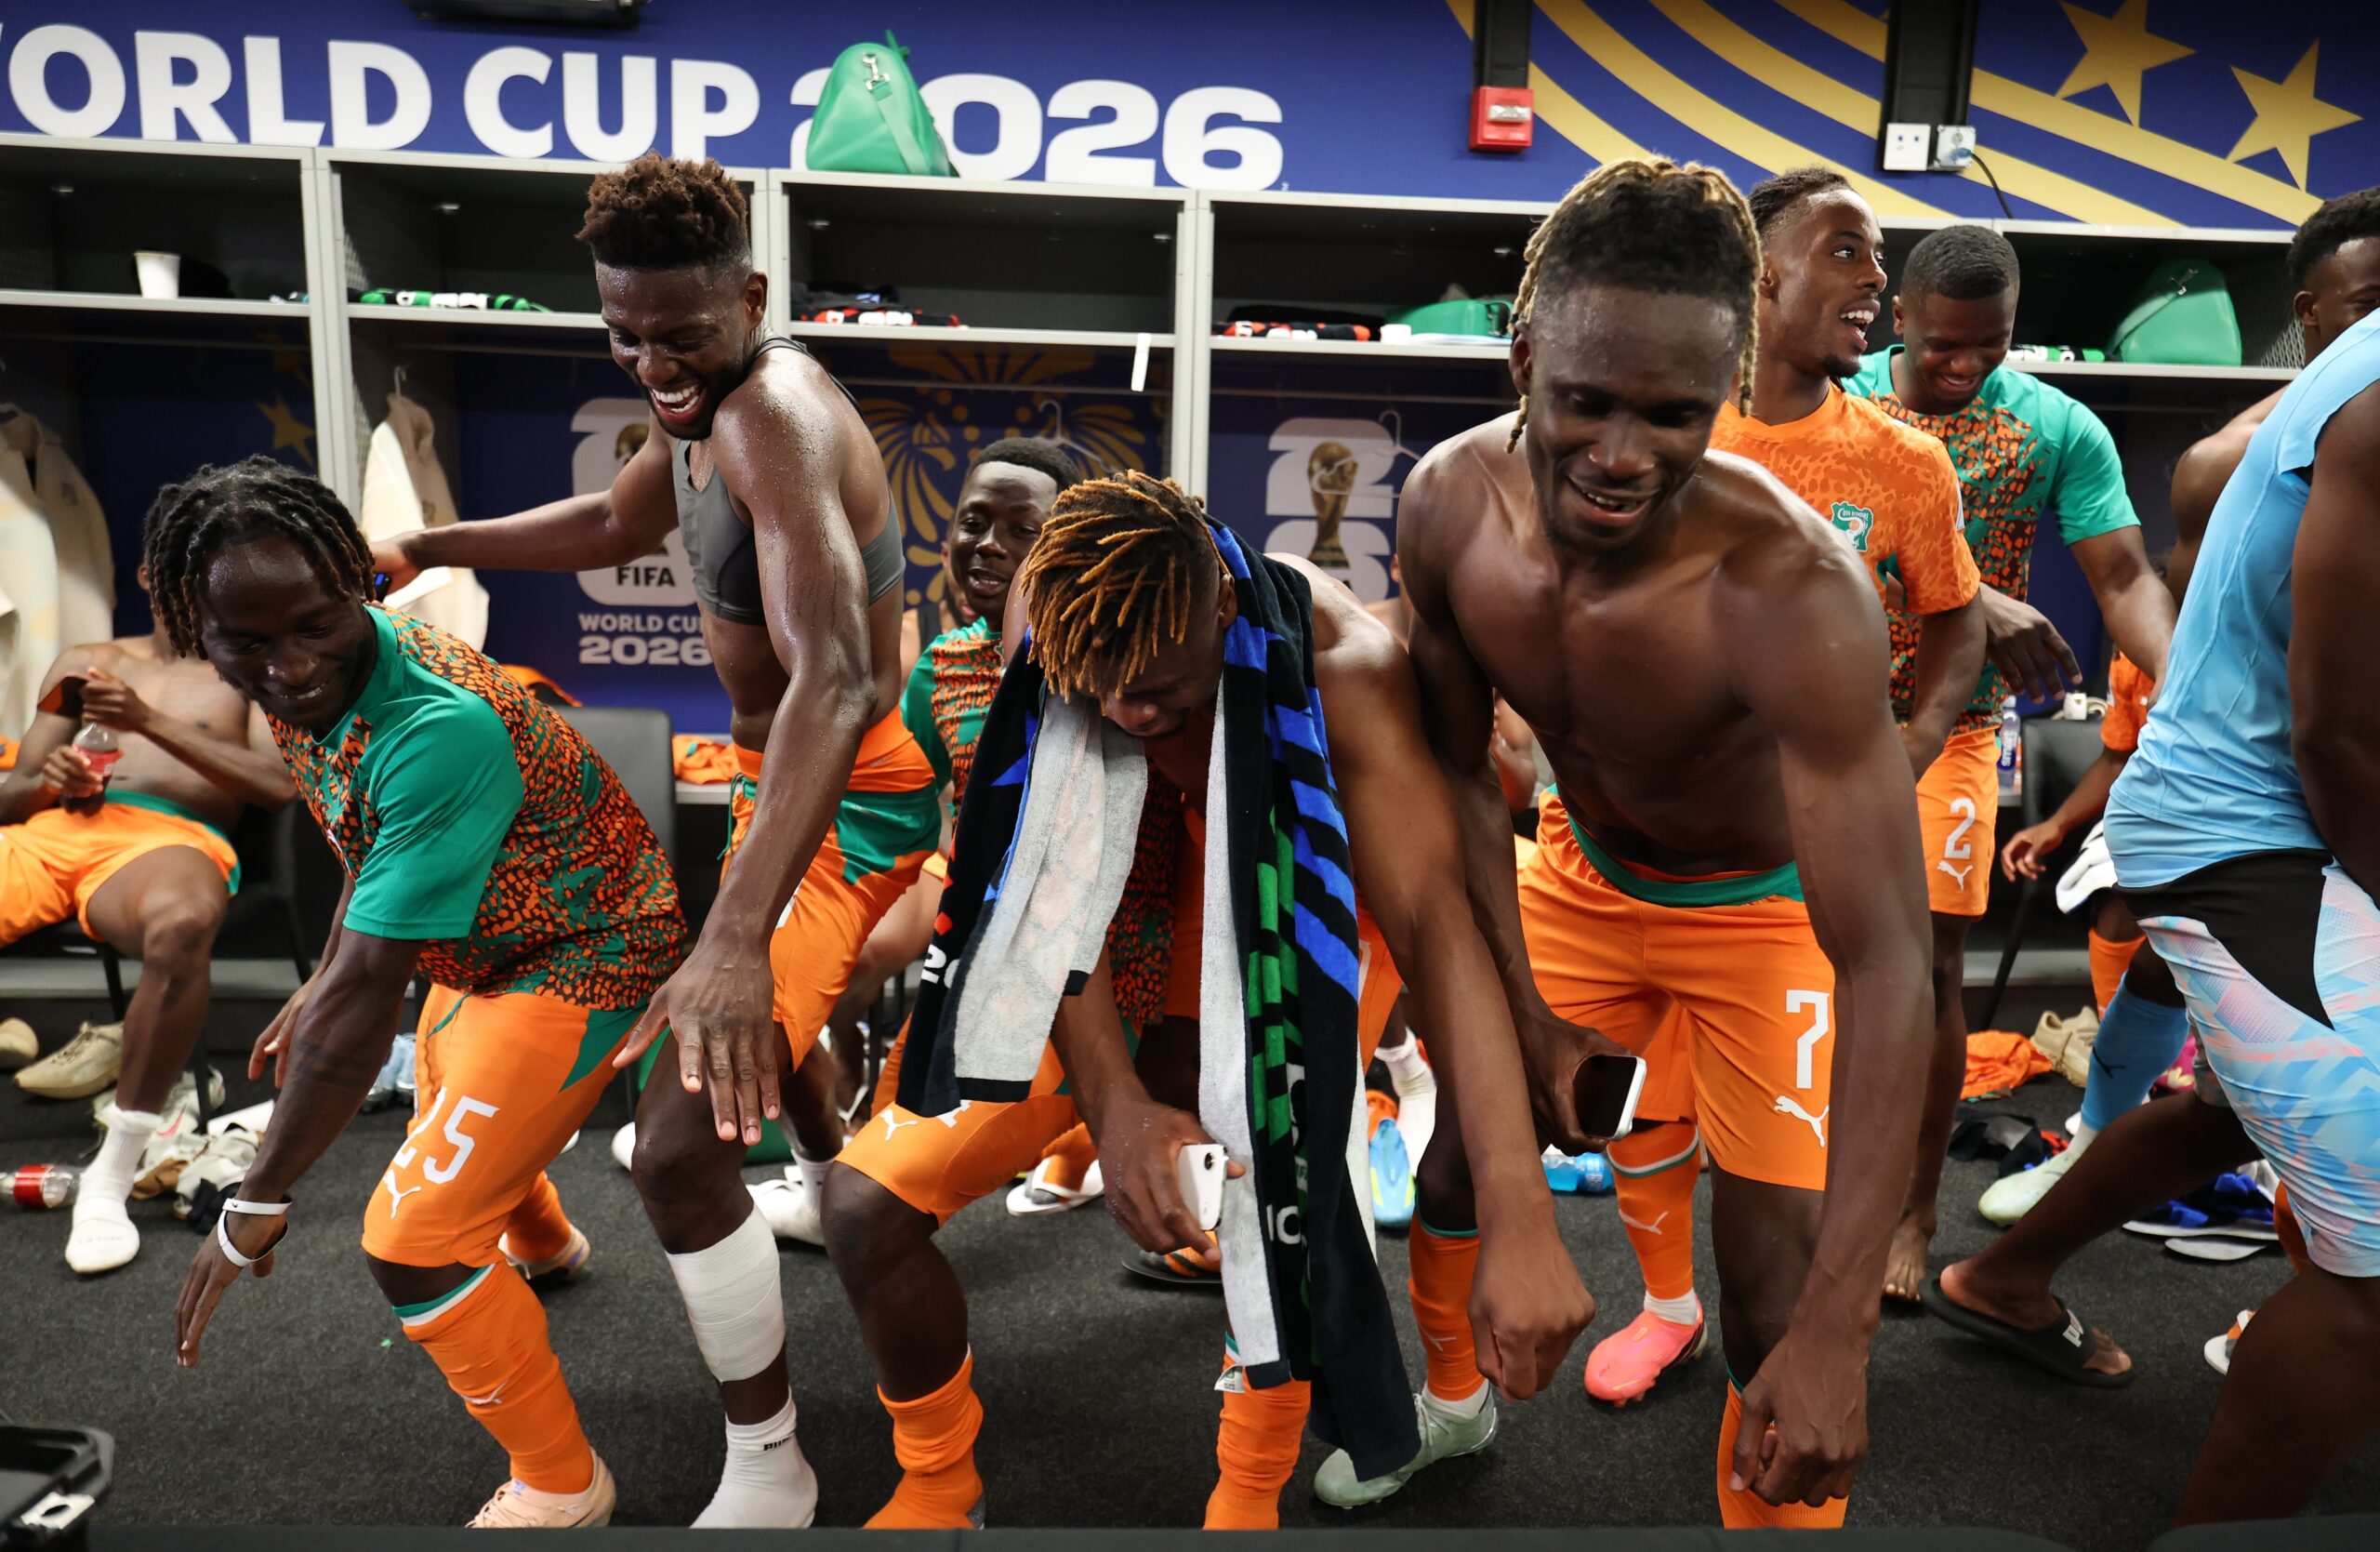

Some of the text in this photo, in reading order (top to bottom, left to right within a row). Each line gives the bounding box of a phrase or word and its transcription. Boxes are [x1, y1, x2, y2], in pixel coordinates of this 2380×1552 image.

[0, 24, 1283, 191] ORLD CUP 026
[616, 565, 676, 587] FIFA
[578, 614, 703, 633] WORLD CU
[578, 635, 714, 667] 2026
[1944, 797, 1976, 859] 2
[1785, 989, 1830, 1089] 7
